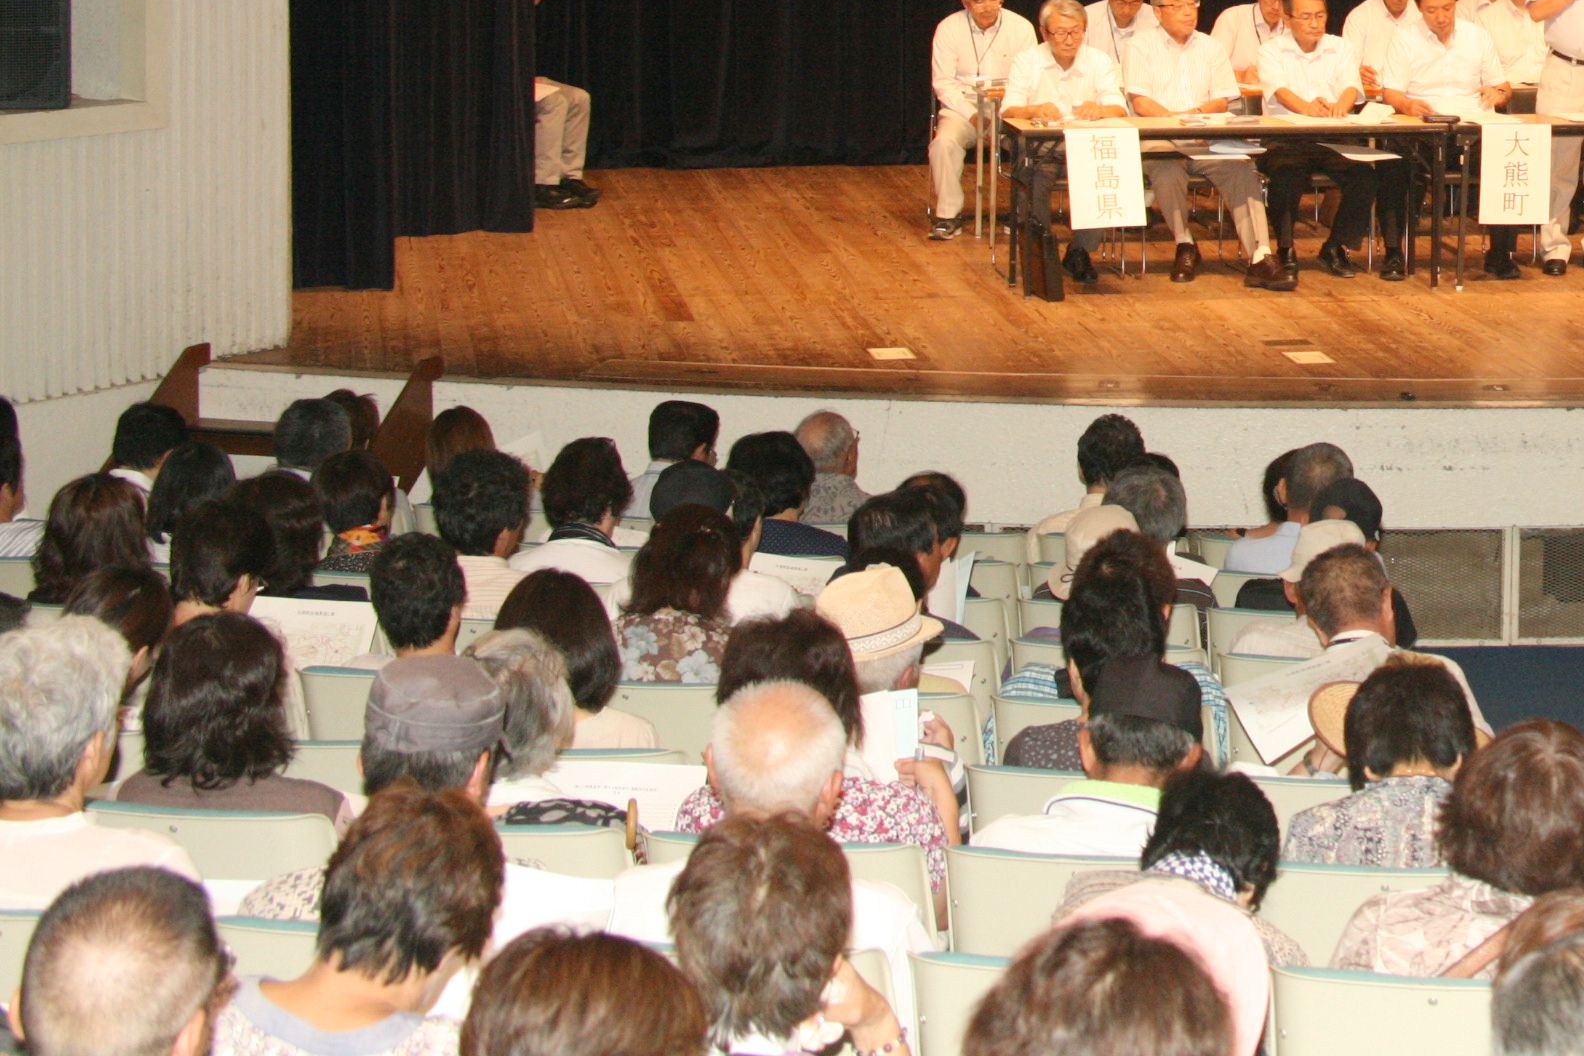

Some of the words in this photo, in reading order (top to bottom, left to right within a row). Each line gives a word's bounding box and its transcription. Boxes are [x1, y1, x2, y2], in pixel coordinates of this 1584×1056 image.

[1089, 134, 1123, 220] 福島県
[1503, 130, 1530, 217] 大熊町
